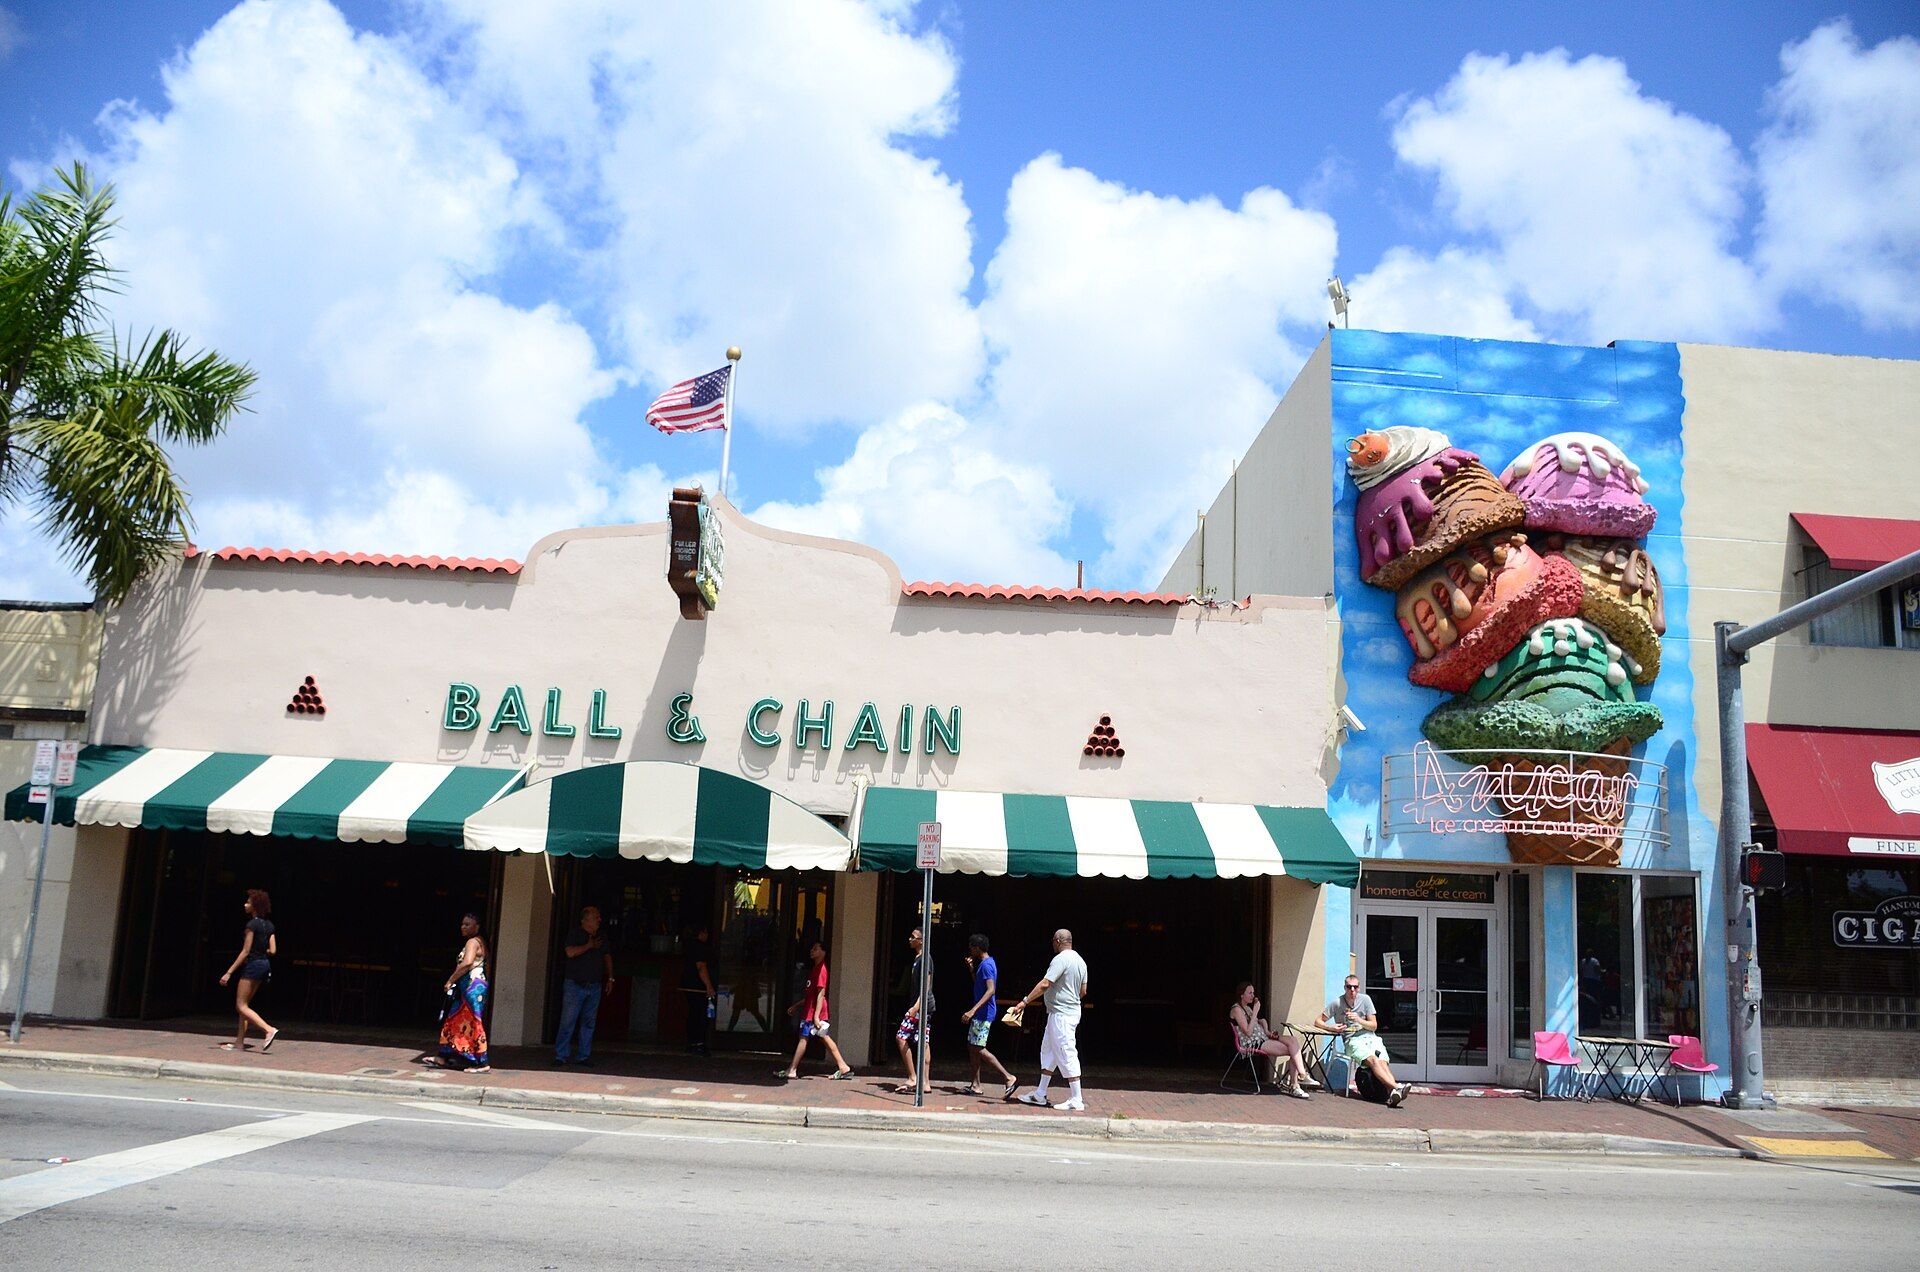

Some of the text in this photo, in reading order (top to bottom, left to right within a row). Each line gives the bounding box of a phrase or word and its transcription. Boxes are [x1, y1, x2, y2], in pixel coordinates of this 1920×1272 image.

[443, 682, 962, 755] BALL & CHAIN
[1403, 740, 1638, 824] Azucar
[926, 825, 935, 833] NO
[1464, 818, 1525, 835] cream
[1532, 820, 1619, 841] company
[920, 834, 940, 843] PARKING
[1877, 841, 1917, 853] FINE
[1366, 885, 1487, 900] homemade ice cream
